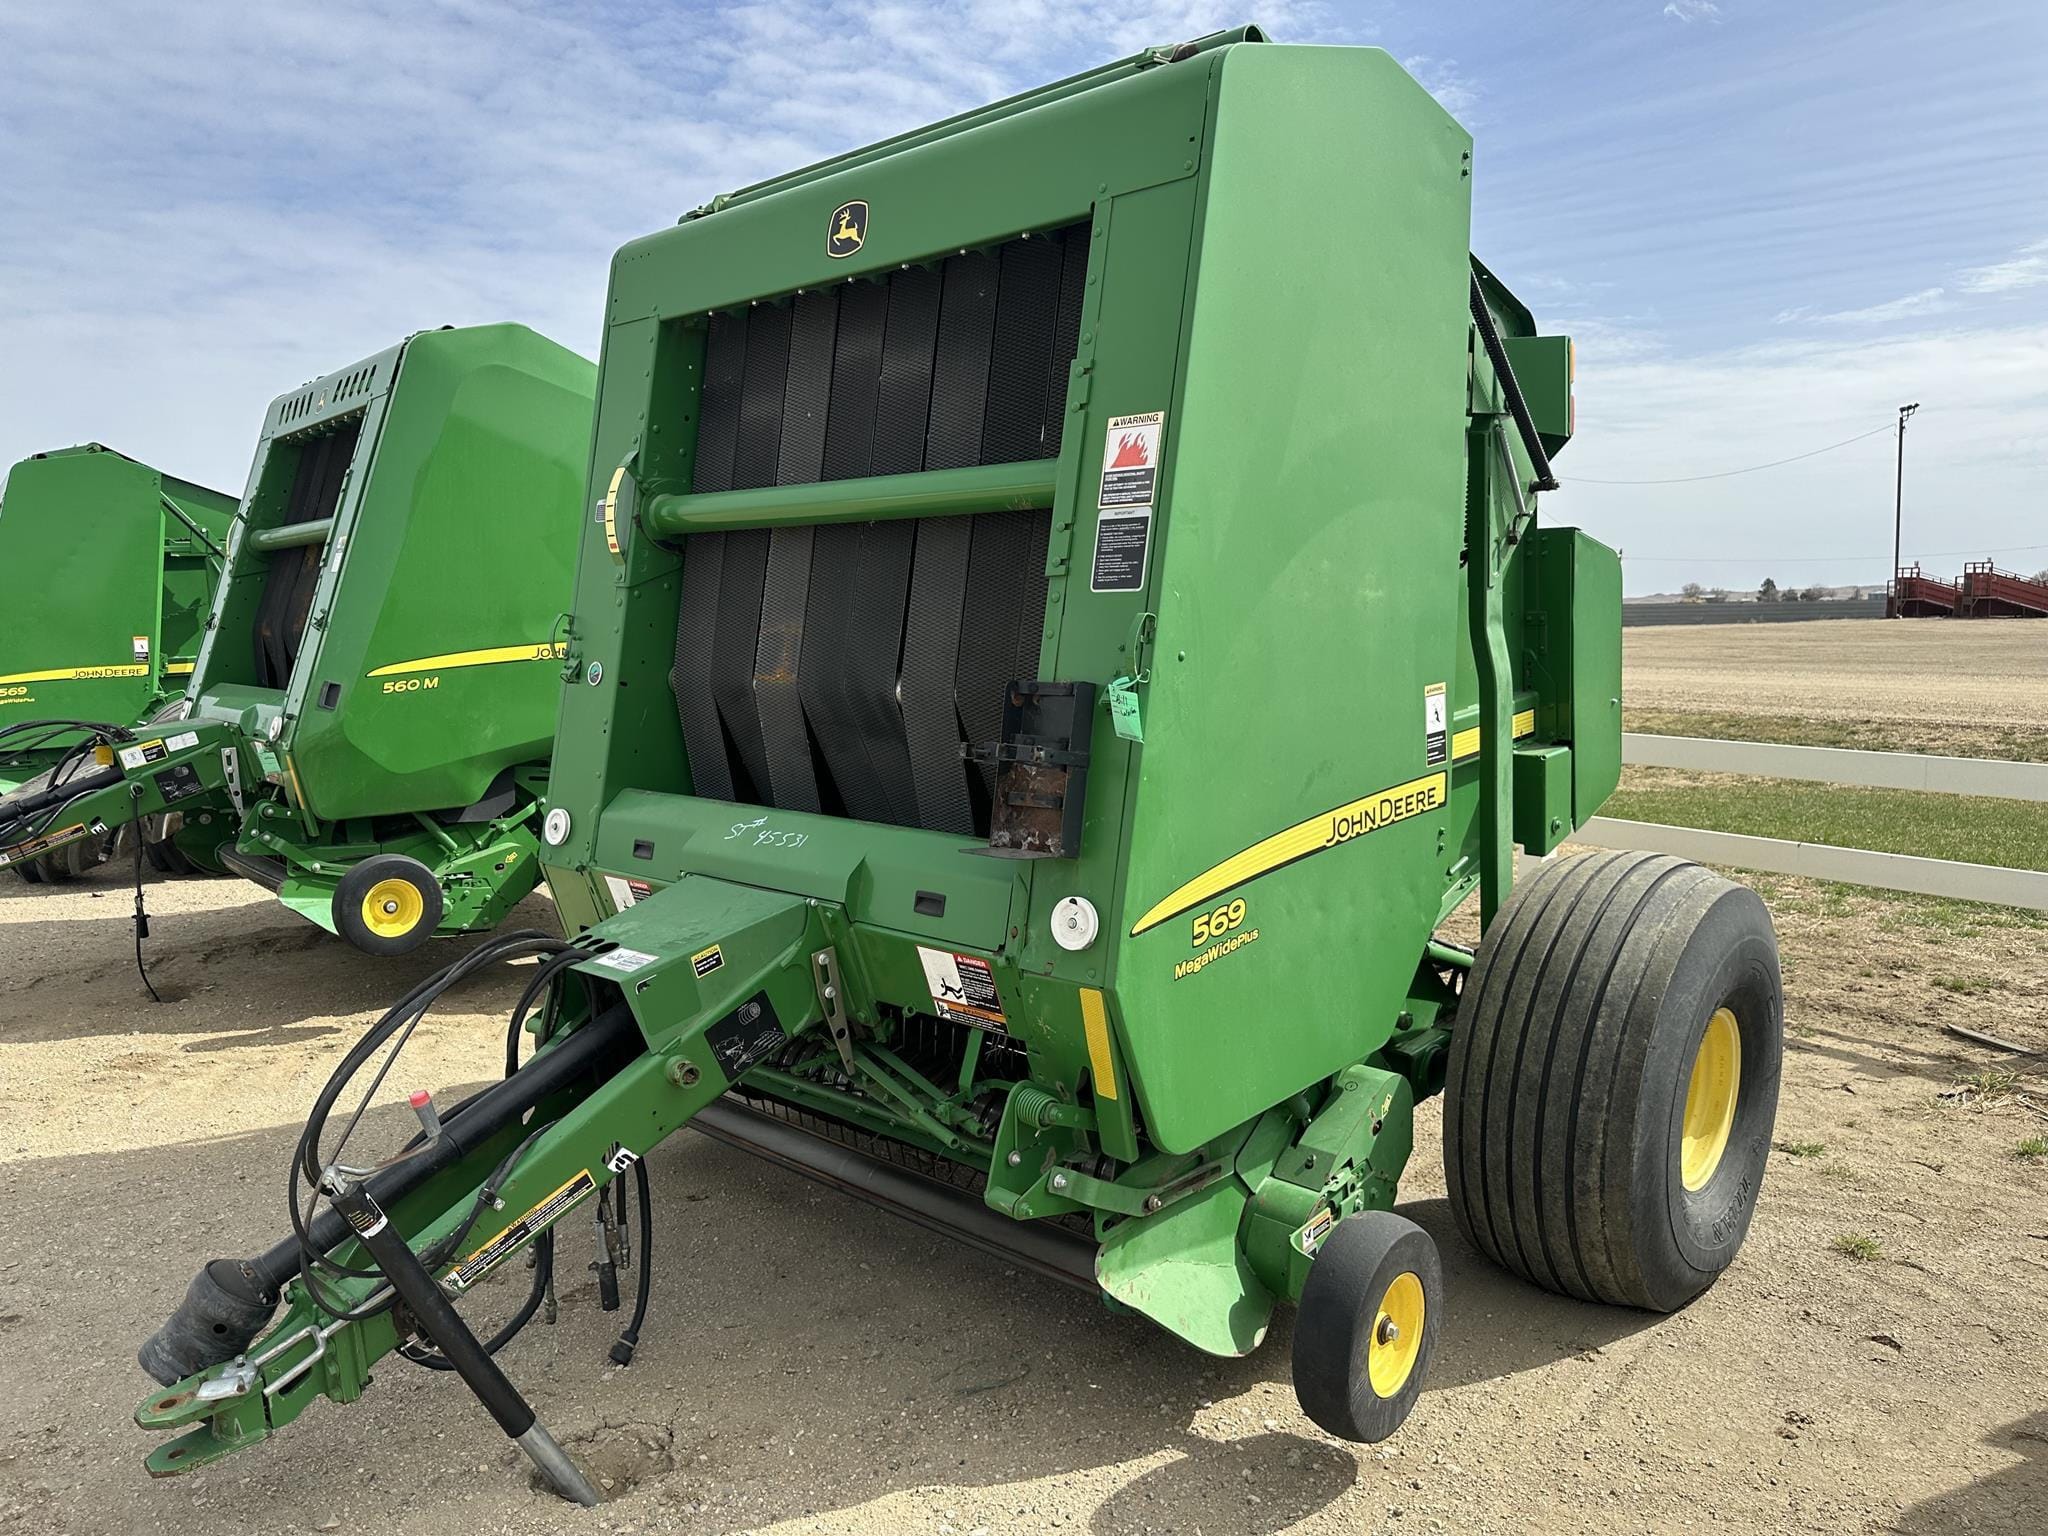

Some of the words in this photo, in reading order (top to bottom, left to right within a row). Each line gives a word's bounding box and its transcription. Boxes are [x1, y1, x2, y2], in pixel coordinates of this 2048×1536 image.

[1120, 413, 1159, 427] WARNING
[73, 669, 103, 678] JOHN
[104, 668, 143, 677] DEERE
[0, 686, 28, 697] 569
[382, 678, 422, 694] 560
[423, 677, 439, 690] M
[1326, 806, 1377, 844] JOHN
[1379, 786, 1437, 824] DEERE
[753, 830, 809, 848] 45531
[1192, 898, 1247, 948] 569
[962, 957, 986, 967] DANGER
[1174, 928, 1260, 981] MegaWidePlus
